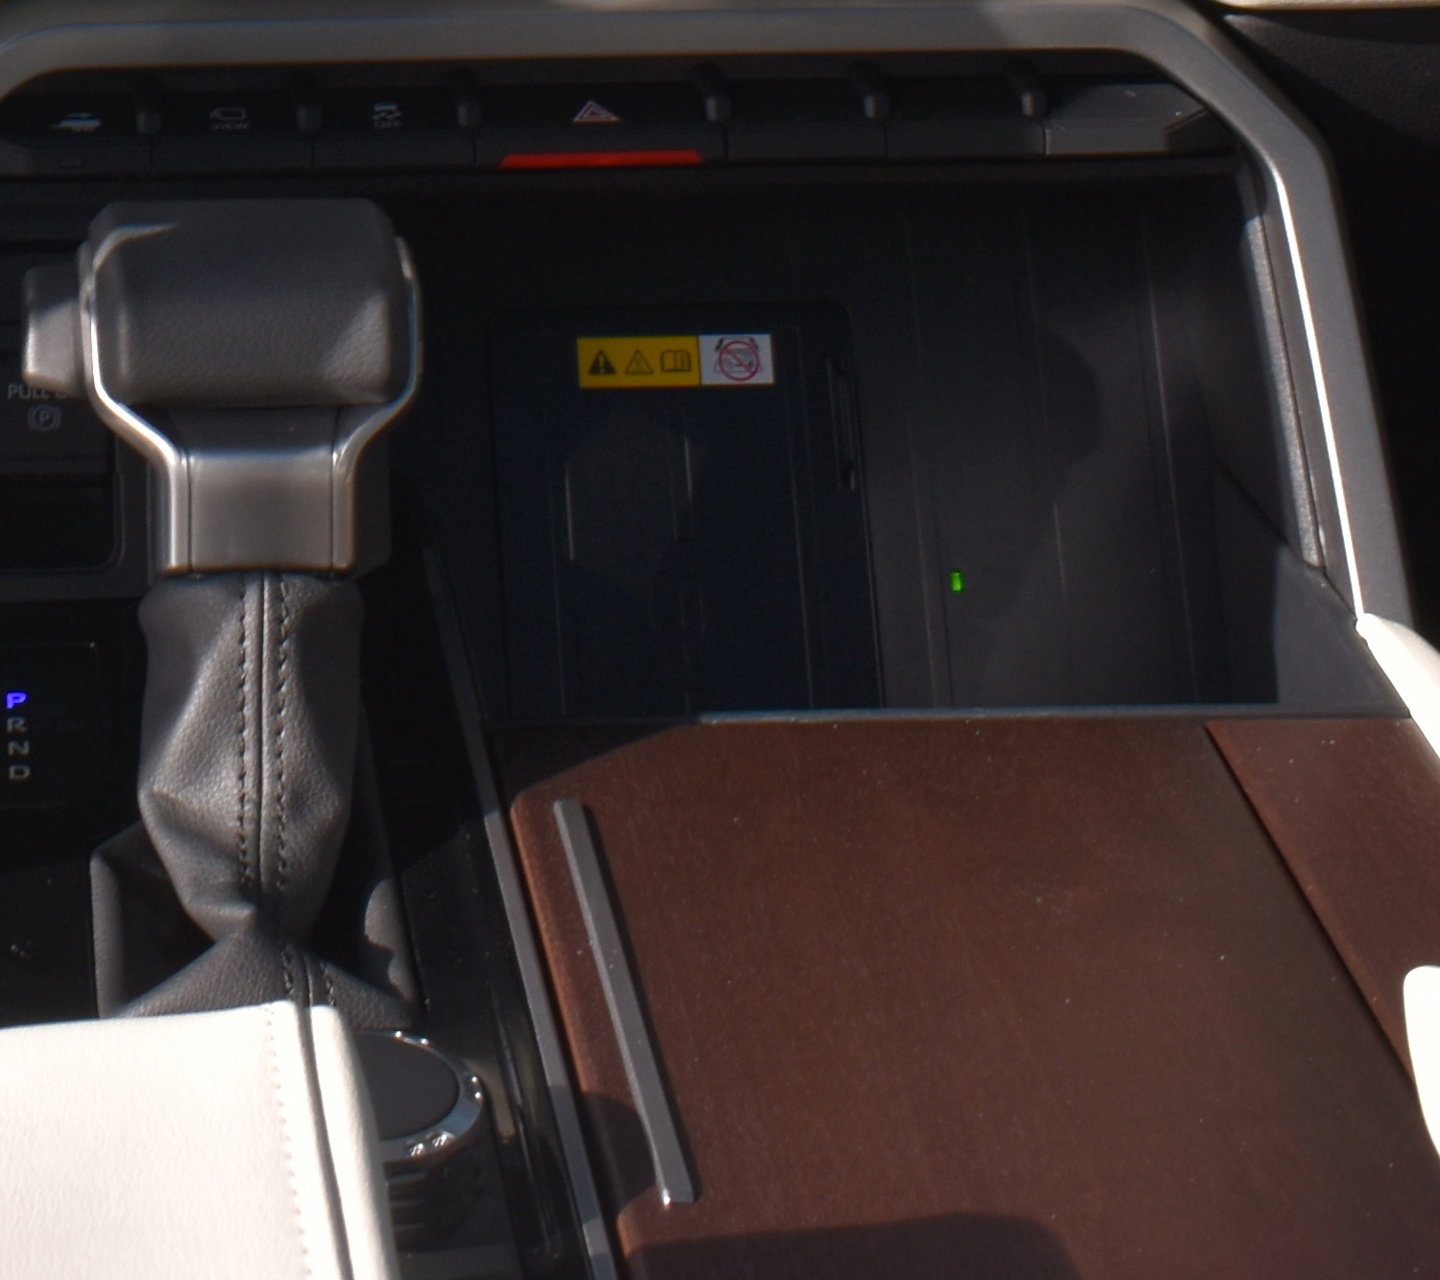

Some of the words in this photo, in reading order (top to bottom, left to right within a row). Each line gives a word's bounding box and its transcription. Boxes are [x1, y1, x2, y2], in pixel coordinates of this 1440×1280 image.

[5, 690, 29, 709] P
[5, 715, 27, 735] R
[6, 739, 31, 758] N
[7, 763, 32, 781] D
